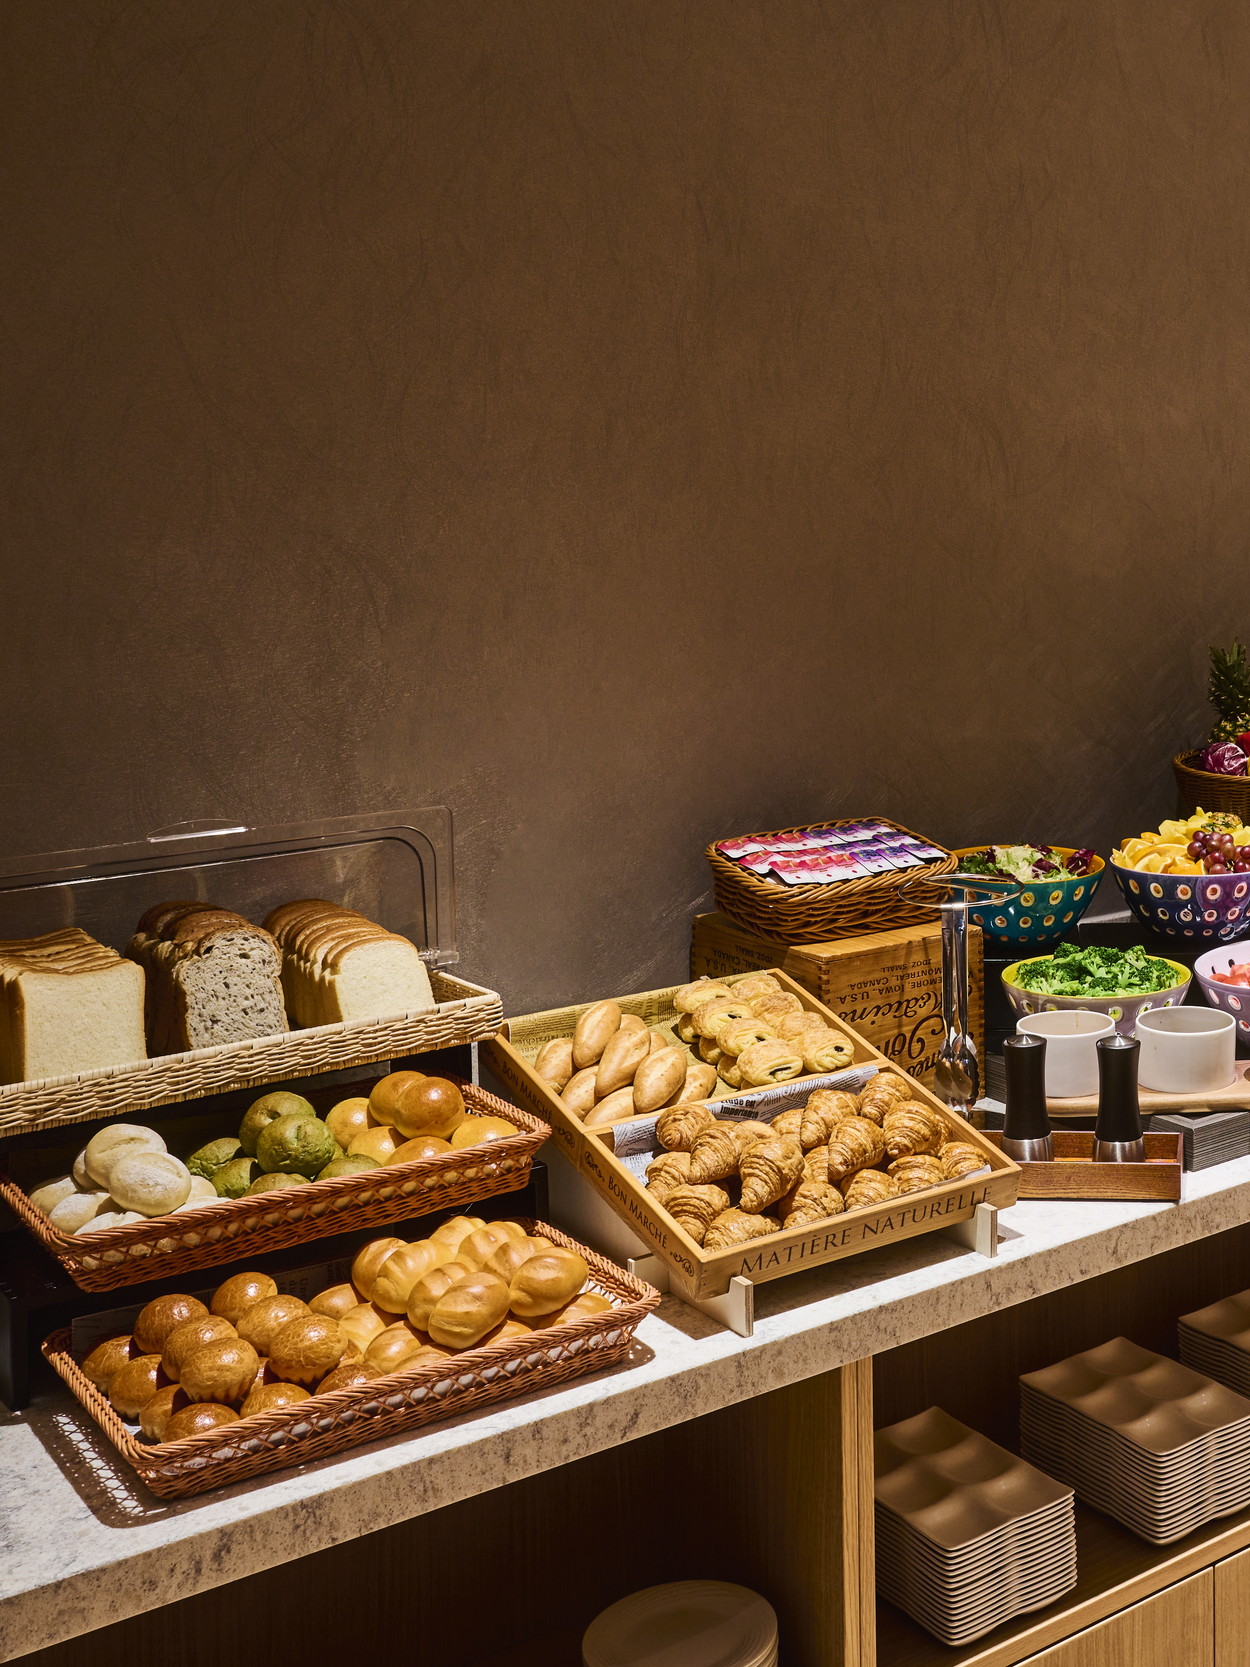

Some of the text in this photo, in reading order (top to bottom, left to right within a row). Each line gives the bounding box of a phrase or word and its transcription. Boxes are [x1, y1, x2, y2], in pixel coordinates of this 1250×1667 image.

[880, 963, 908, 974] SMALL
[847, 976, 889, 991] CANADA.
[836, 991, 870, 1005] U.S.A.
[607, 1175, 628, 1206] BON
[628, 1199, 668, 1250] MARCHÉ
[740, 1185, 992, 1276] MATIÈRE NATURELLE
